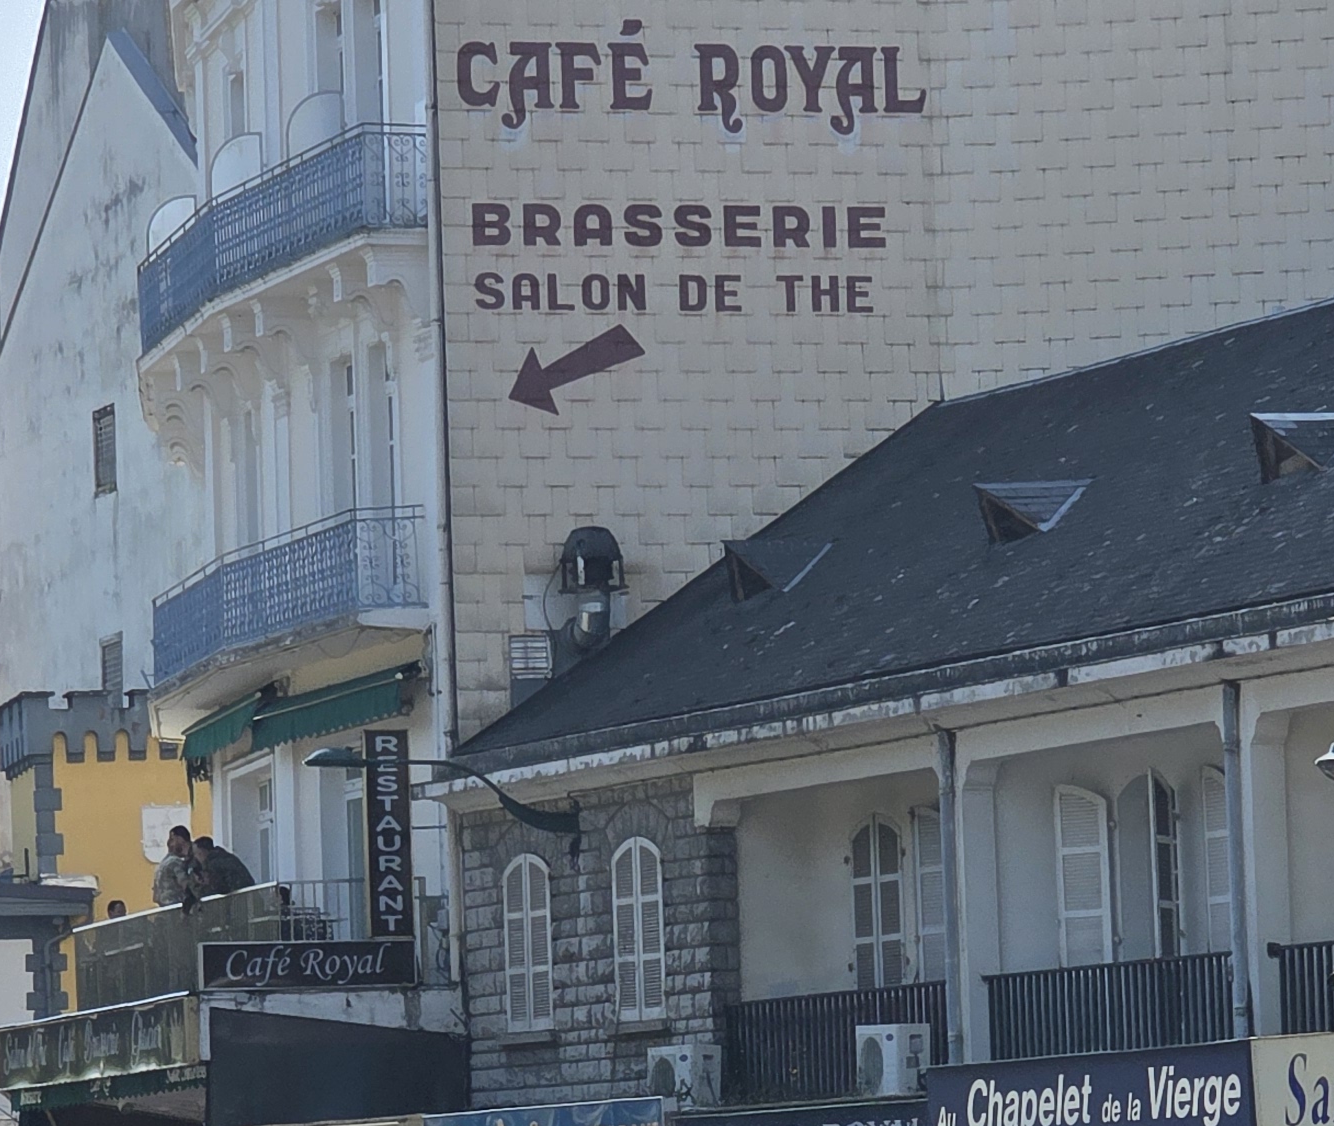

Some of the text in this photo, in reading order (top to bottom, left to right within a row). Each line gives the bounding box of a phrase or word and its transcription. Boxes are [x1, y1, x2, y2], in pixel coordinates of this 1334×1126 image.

[457, 19, 927, 136] CAFÉ ROYAL
[472, 203, 886, 249] BRASSERIE
[474, 272, 874, 314] SALON DE THE
[375, 736, 403, 932] RESTAURANT
[225, 943, 388, 985] Café Royal
[1101, 1095, 1121, 1122] de
[1126, 1092, 1141, 1122] la
